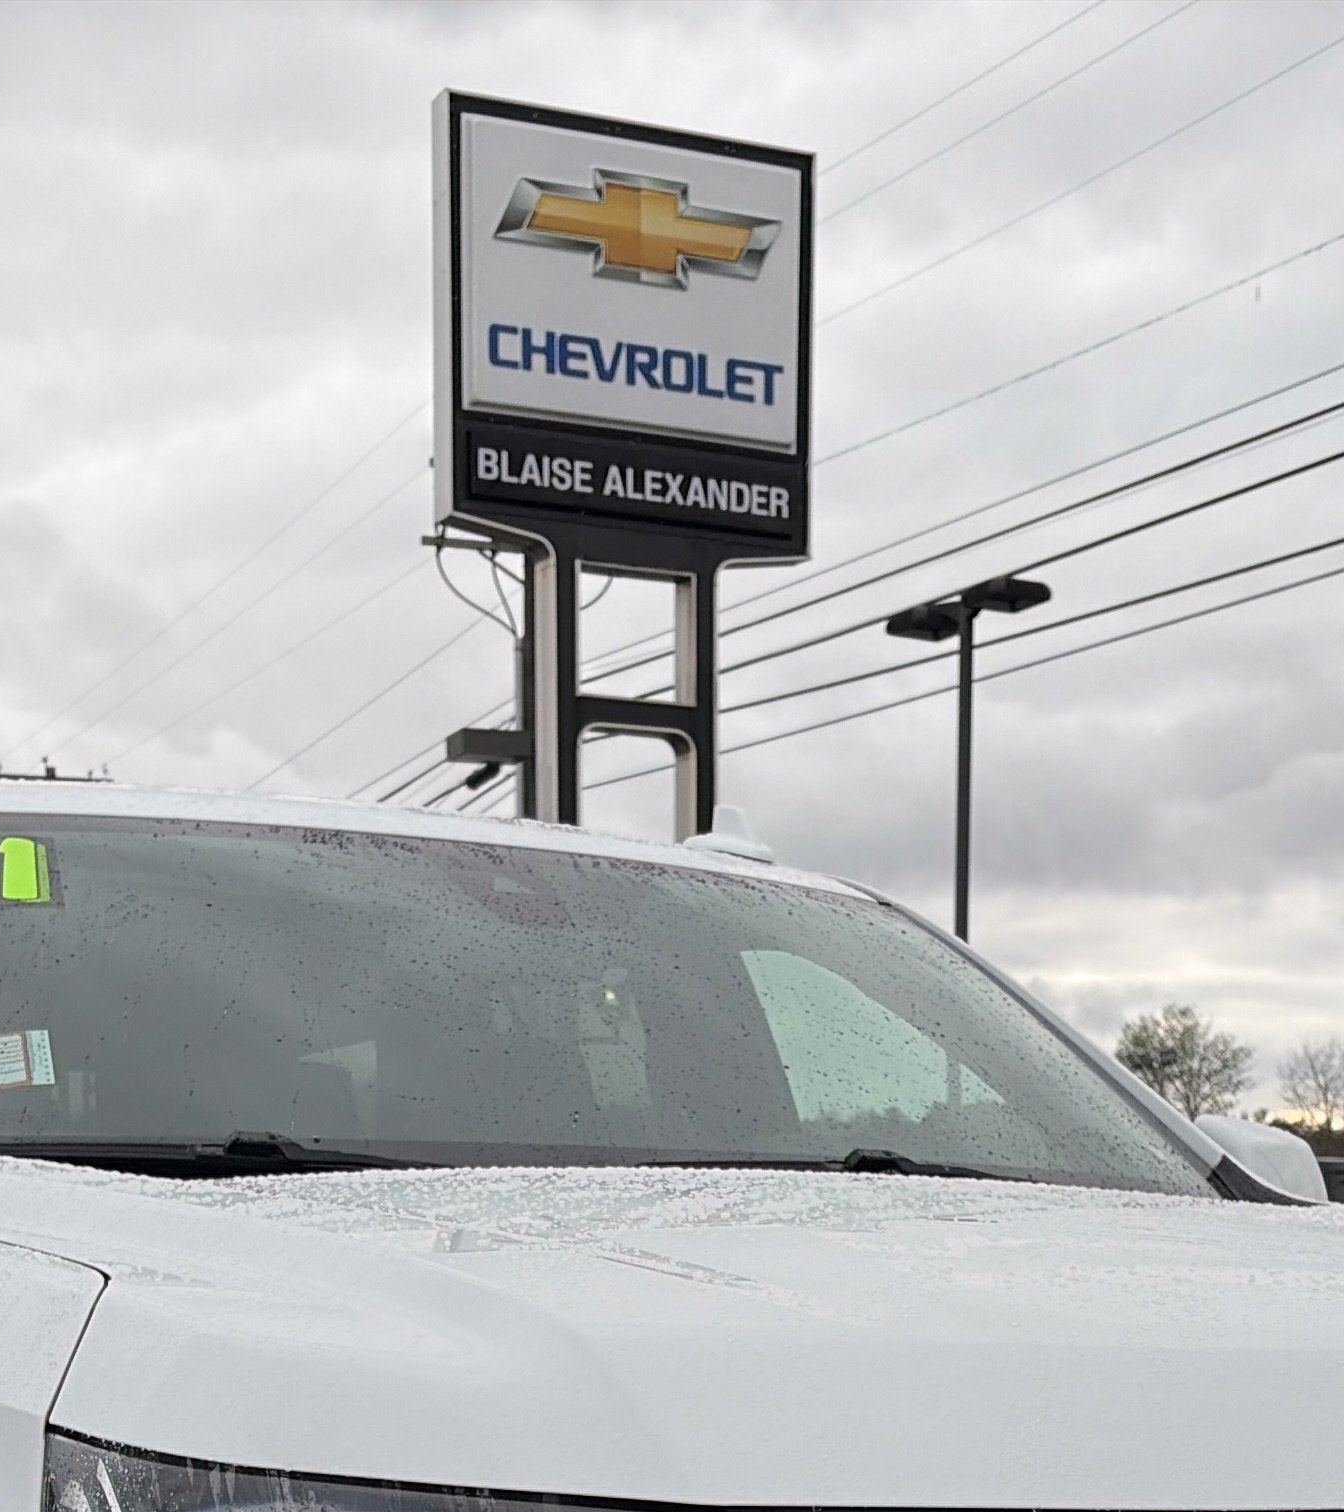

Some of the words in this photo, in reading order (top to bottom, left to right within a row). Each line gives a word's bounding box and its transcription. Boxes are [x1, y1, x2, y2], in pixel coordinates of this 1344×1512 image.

[488, 322, 784, 406] CHEVROLET
[476, 448, 594, 494] BLAISE
[602, 465, 791, 519] ALEXANDER
